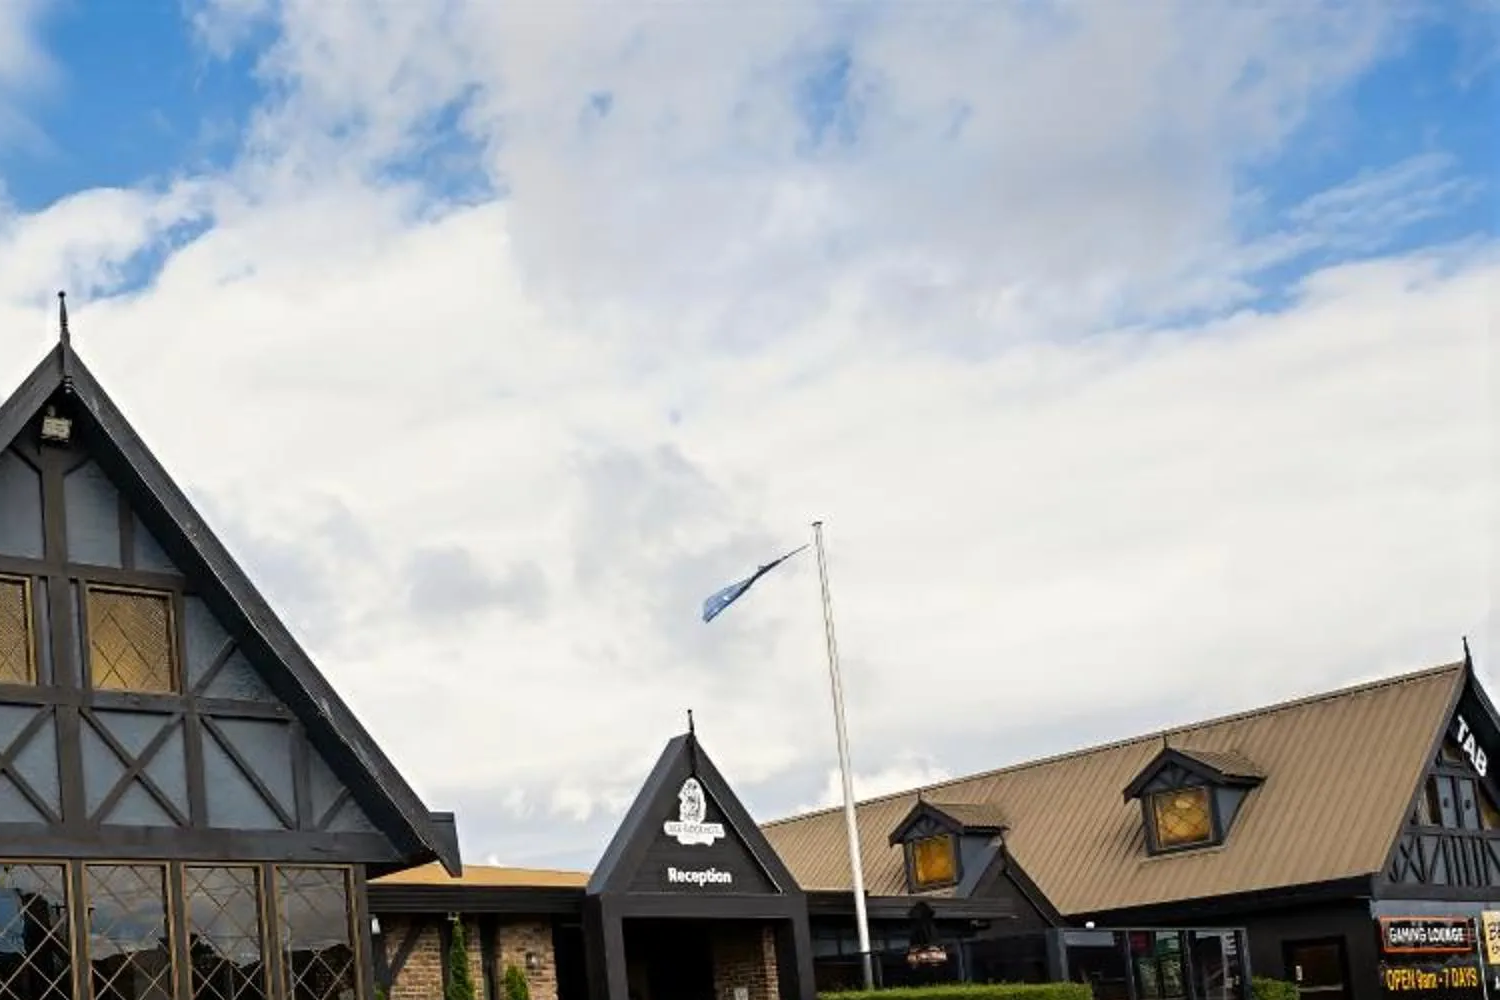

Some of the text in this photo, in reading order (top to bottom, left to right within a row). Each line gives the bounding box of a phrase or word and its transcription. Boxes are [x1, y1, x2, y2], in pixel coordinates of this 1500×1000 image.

[1457, 714, 1488, 777] TAB
[667, 867, 732, 887] Reception
[1389, 927, 1464, 943] GAMING LOUNGE
[1386, 968, 1416, 991] OPEN
[1451, 967, 1478, 987] DAYS
